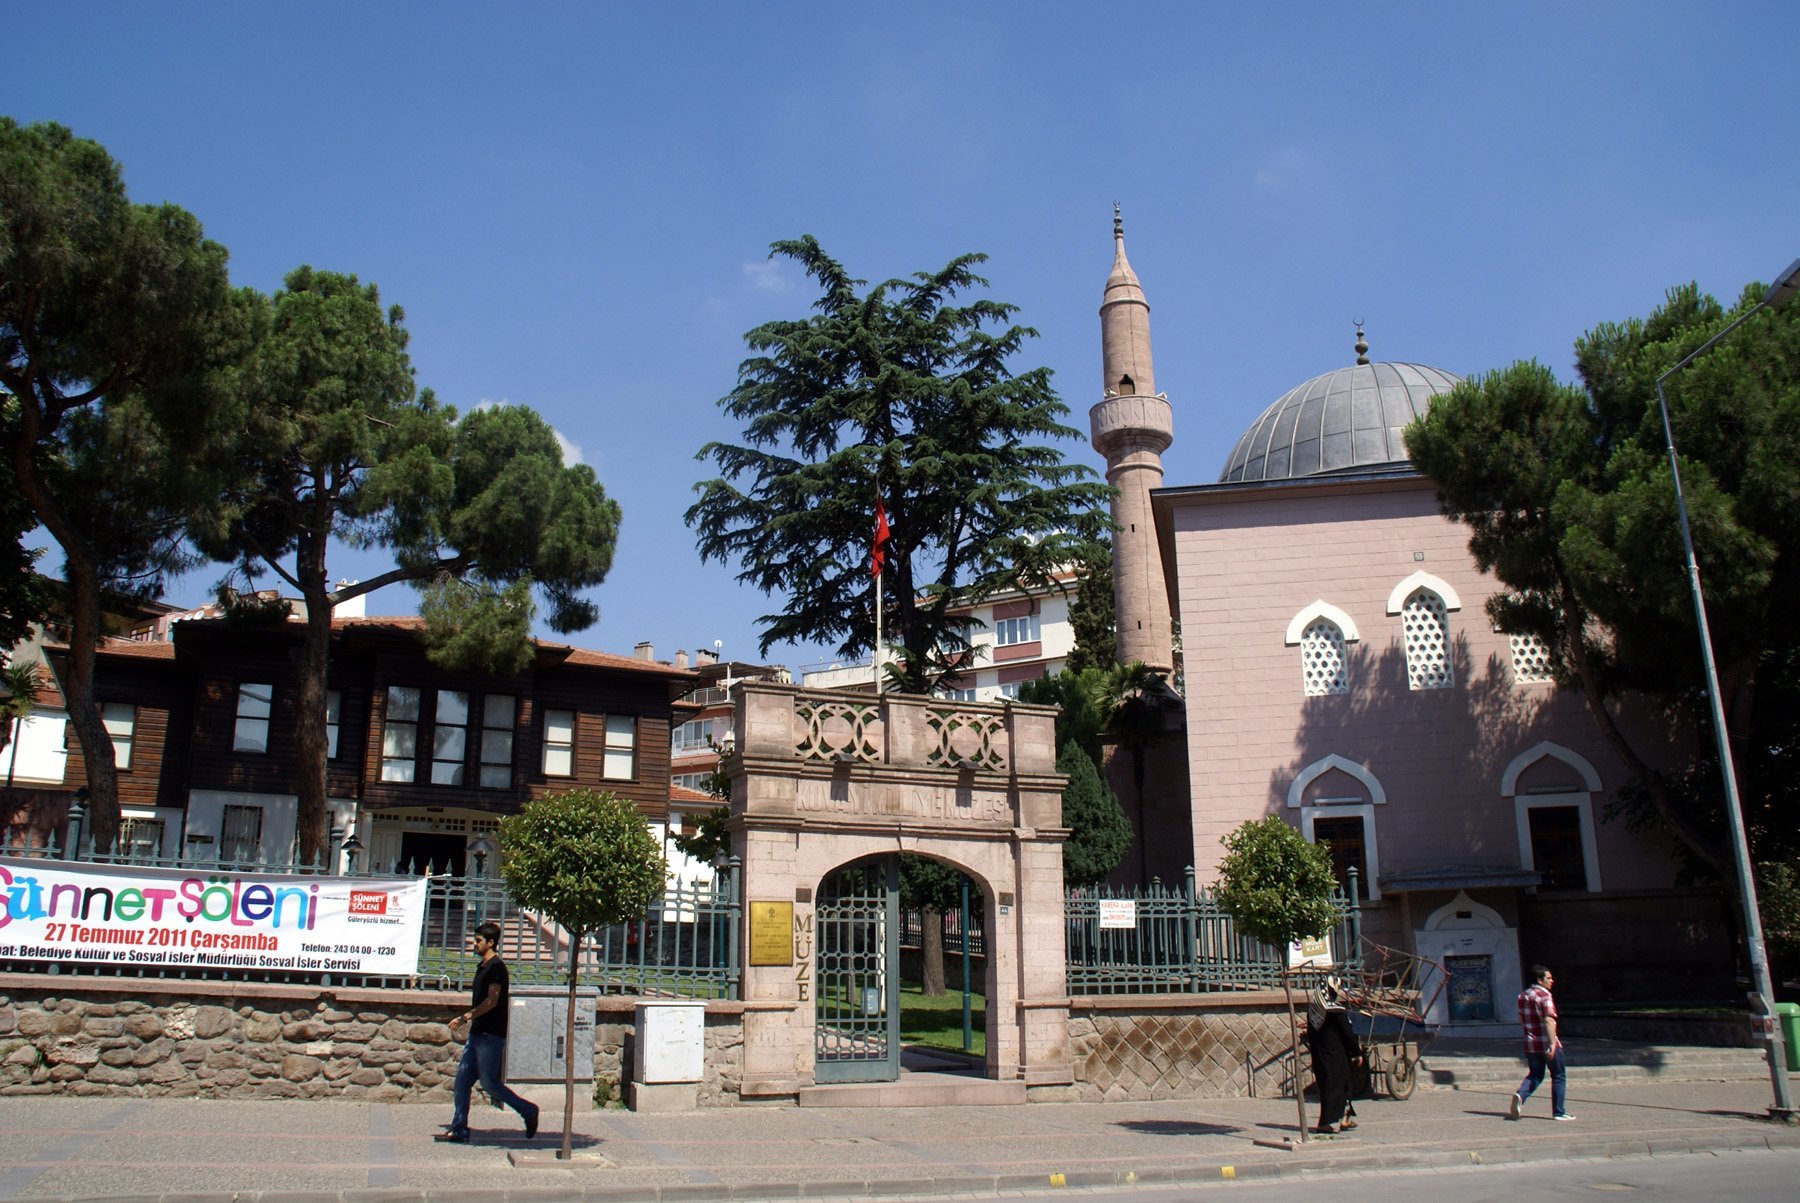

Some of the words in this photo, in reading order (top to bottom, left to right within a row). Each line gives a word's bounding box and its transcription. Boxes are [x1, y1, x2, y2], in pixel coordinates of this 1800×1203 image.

[352, 893, 384, 903] SÜNNET
[352, 902, 380, 911] ŞÖLENİ
[347, 916, 378, 924] Güleryüzlü
[44, 923, 66, 942] 27
[70, 924, 144, 945] Temmuz
[147, 927, 187, 948] 2011
[190, 929, 278, 952] Çarşamba
[301, 943, 332, 953] Telefon:
[333, 945, 348, 954] 243
[350, 945, 360, 954] 04
[361, 946, 372, 955] 00
[377, 946, 396, 956] 1230
[19, 945, 72, 959] Belediye
[74, 947, 110, 960] Kültür
[112, 950, 126, 961] ve
[323, 957, 361, 971] Servisi
[795, 914, 812, 1002] MÜZE
